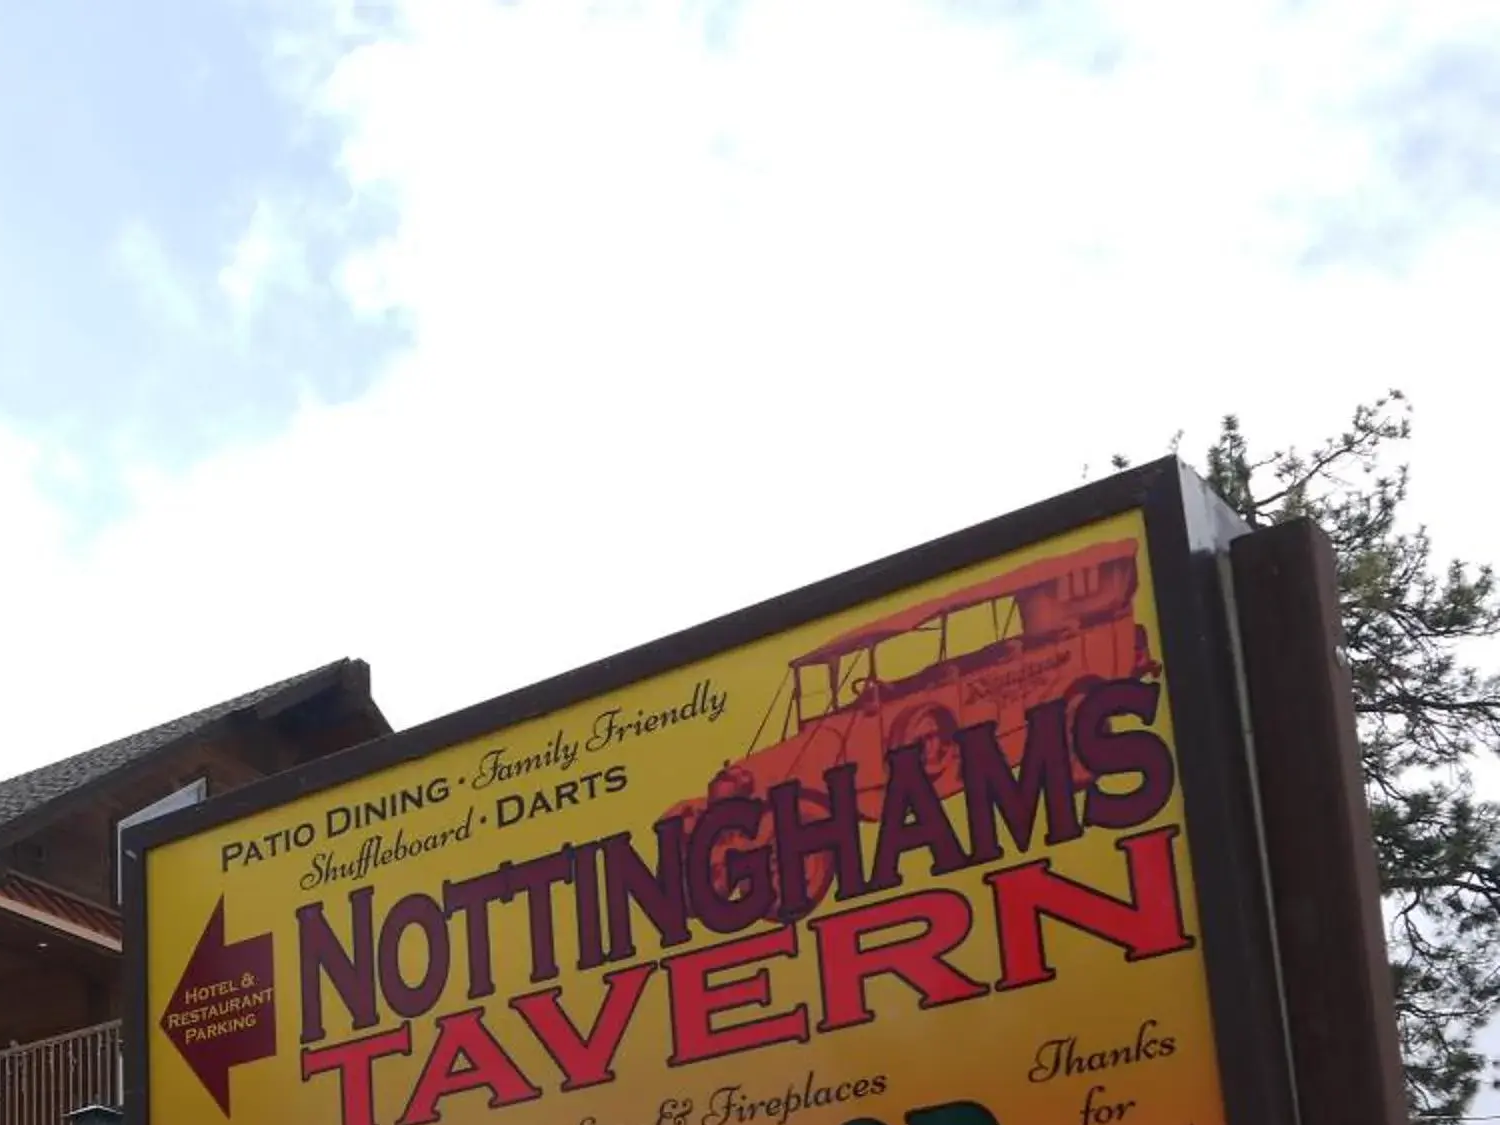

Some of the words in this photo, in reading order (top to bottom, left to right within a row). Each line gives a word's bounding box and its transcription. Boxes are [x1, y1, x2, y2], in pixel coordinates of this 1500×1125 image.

[221, 828, 315, 872] PATIO
[325, 777, 450, 839] DINING
[471, 730, 578, 790] Family
[586, 680, 727, 752] Friendly
[300, 807, 473, 890] Shuffleboard
[496, 765, 628, 828] DARTS
[296, 679, 1174, 1044] NOTTINGHAMS
[167, 987, 275, 1028] RESTAURANT
[185, 979, 239, 1005] HOTEL
[240, 971, 258, 990] &
[185, 1014, 257, 1044] PARKING
[1027, 1020, 1177, 1083] Thanks
